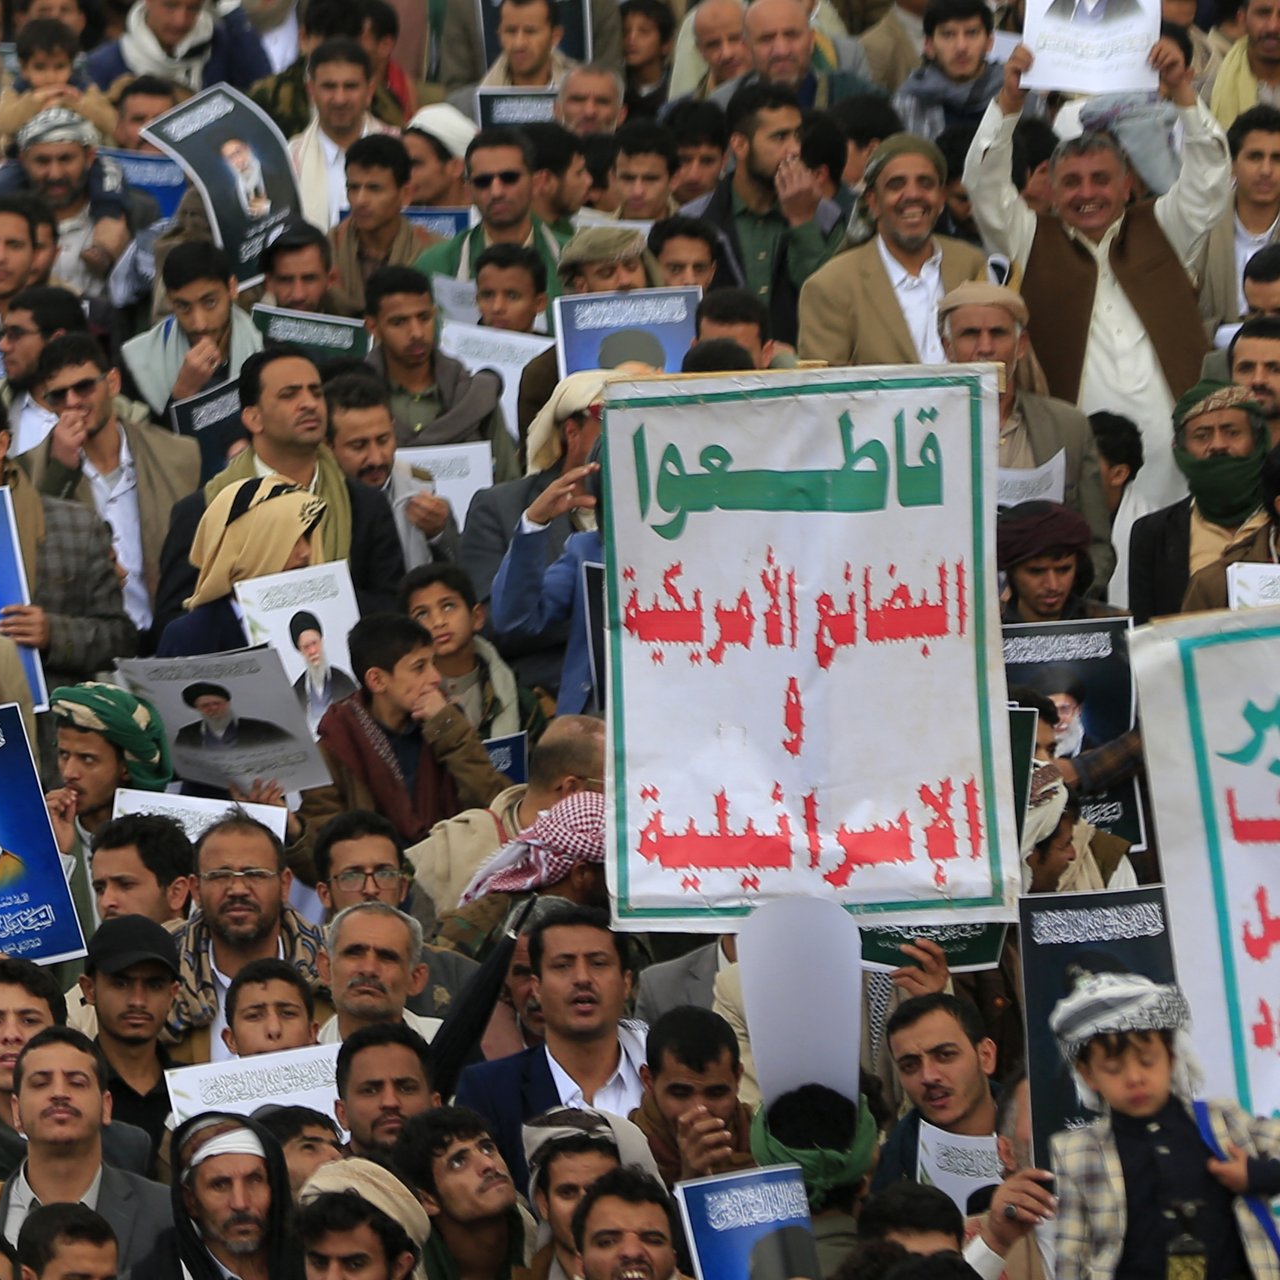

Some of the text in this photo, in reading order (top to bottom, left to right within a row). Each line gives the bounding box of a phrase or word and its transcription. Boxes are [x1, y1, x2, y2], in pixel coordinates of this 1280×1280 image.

[633, 407, 943, 541] قاطعوا
[623, 545, 967, 671] البضائع الأمريكية
[782, 676, 805, 757] و
[636, 774, 983, 890] الإسرائيلية
